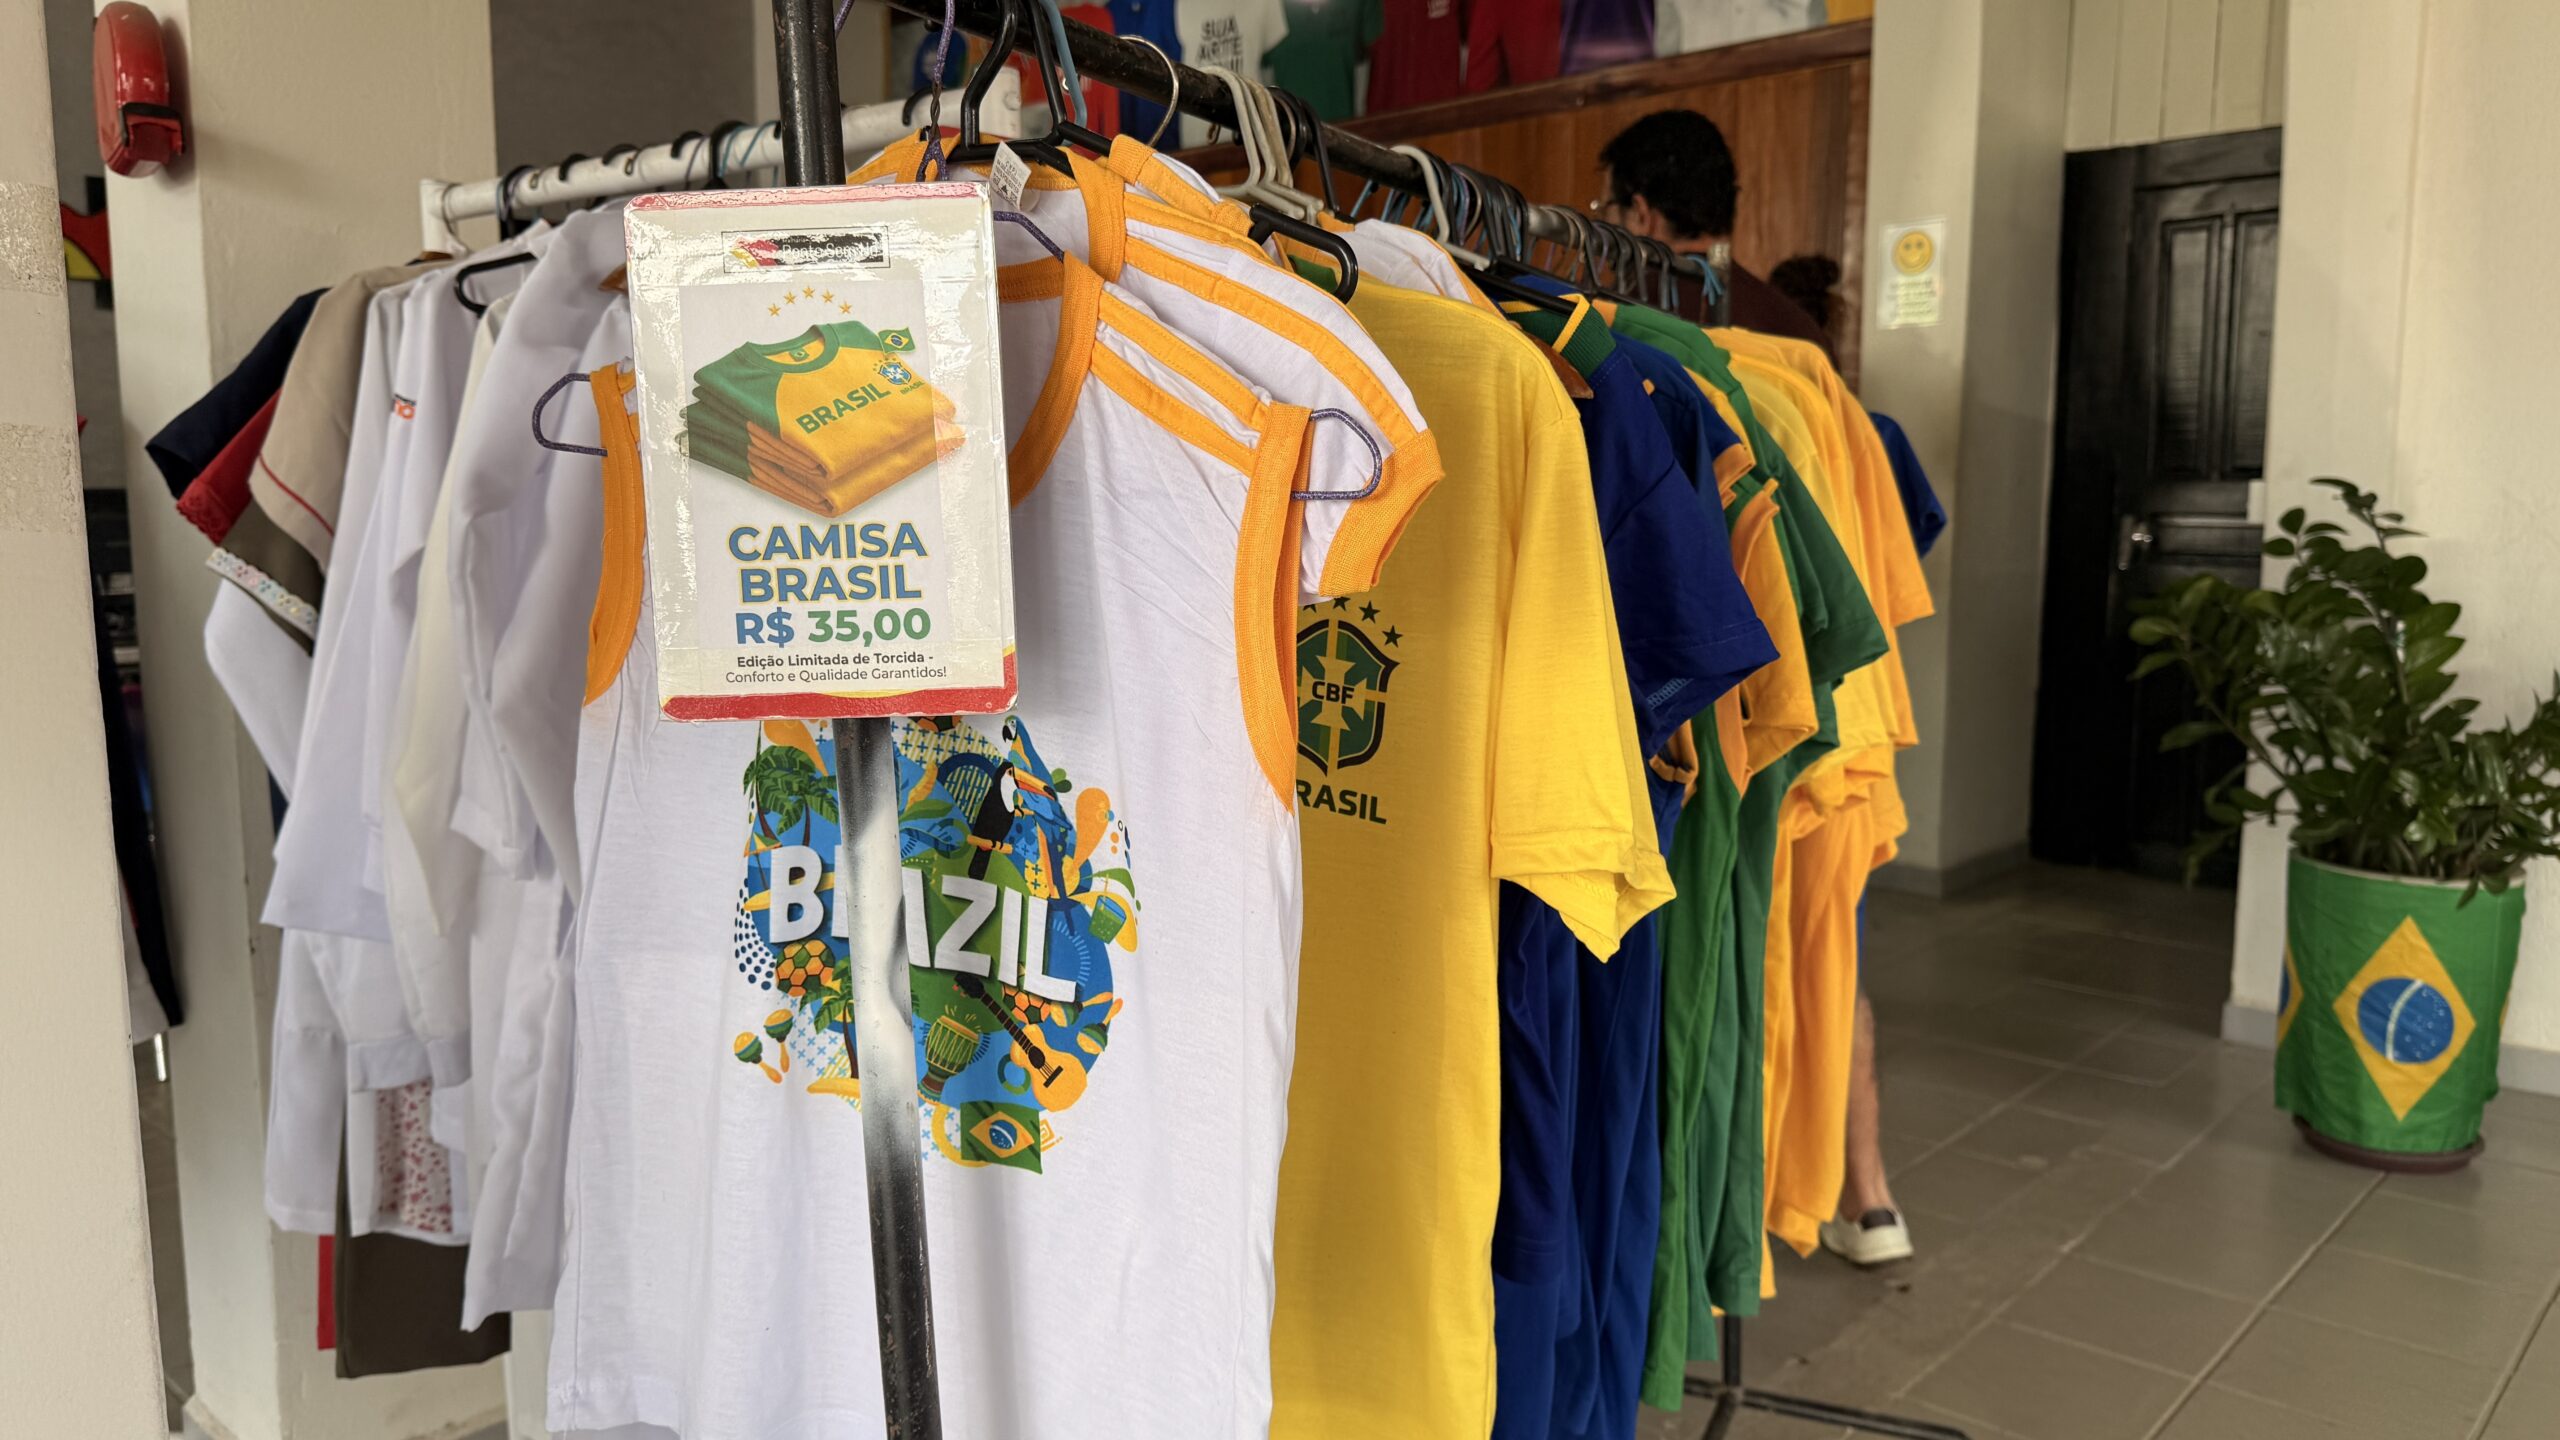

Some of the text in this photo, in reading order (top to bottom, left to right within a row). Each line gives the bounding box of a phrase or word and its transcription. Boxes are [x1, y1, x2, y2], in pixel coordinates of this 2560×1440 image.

[1202, 15, 1239, 41] SUA
[1196, 37, 1243, 63] ARTE
[796, 383, 892, 434] BRASIL
[728, 522, 929, 562] CAMISA
[740, 564, 923, 603] BRASIL
[735, 607, 931, 648] R$ 35,00
[725, 665, 947, 683] Conforto e Qualidade Garantidos!
[737, 656, 784, 670] Edição
[788, 654, 849, 667] Limitada
[853, 653, 870, 665] de
[874, 652, 924, 664] Torcida
[1312, 681, 1355, 704] CBF
[1296, 779, 1387, 825] RASIL
